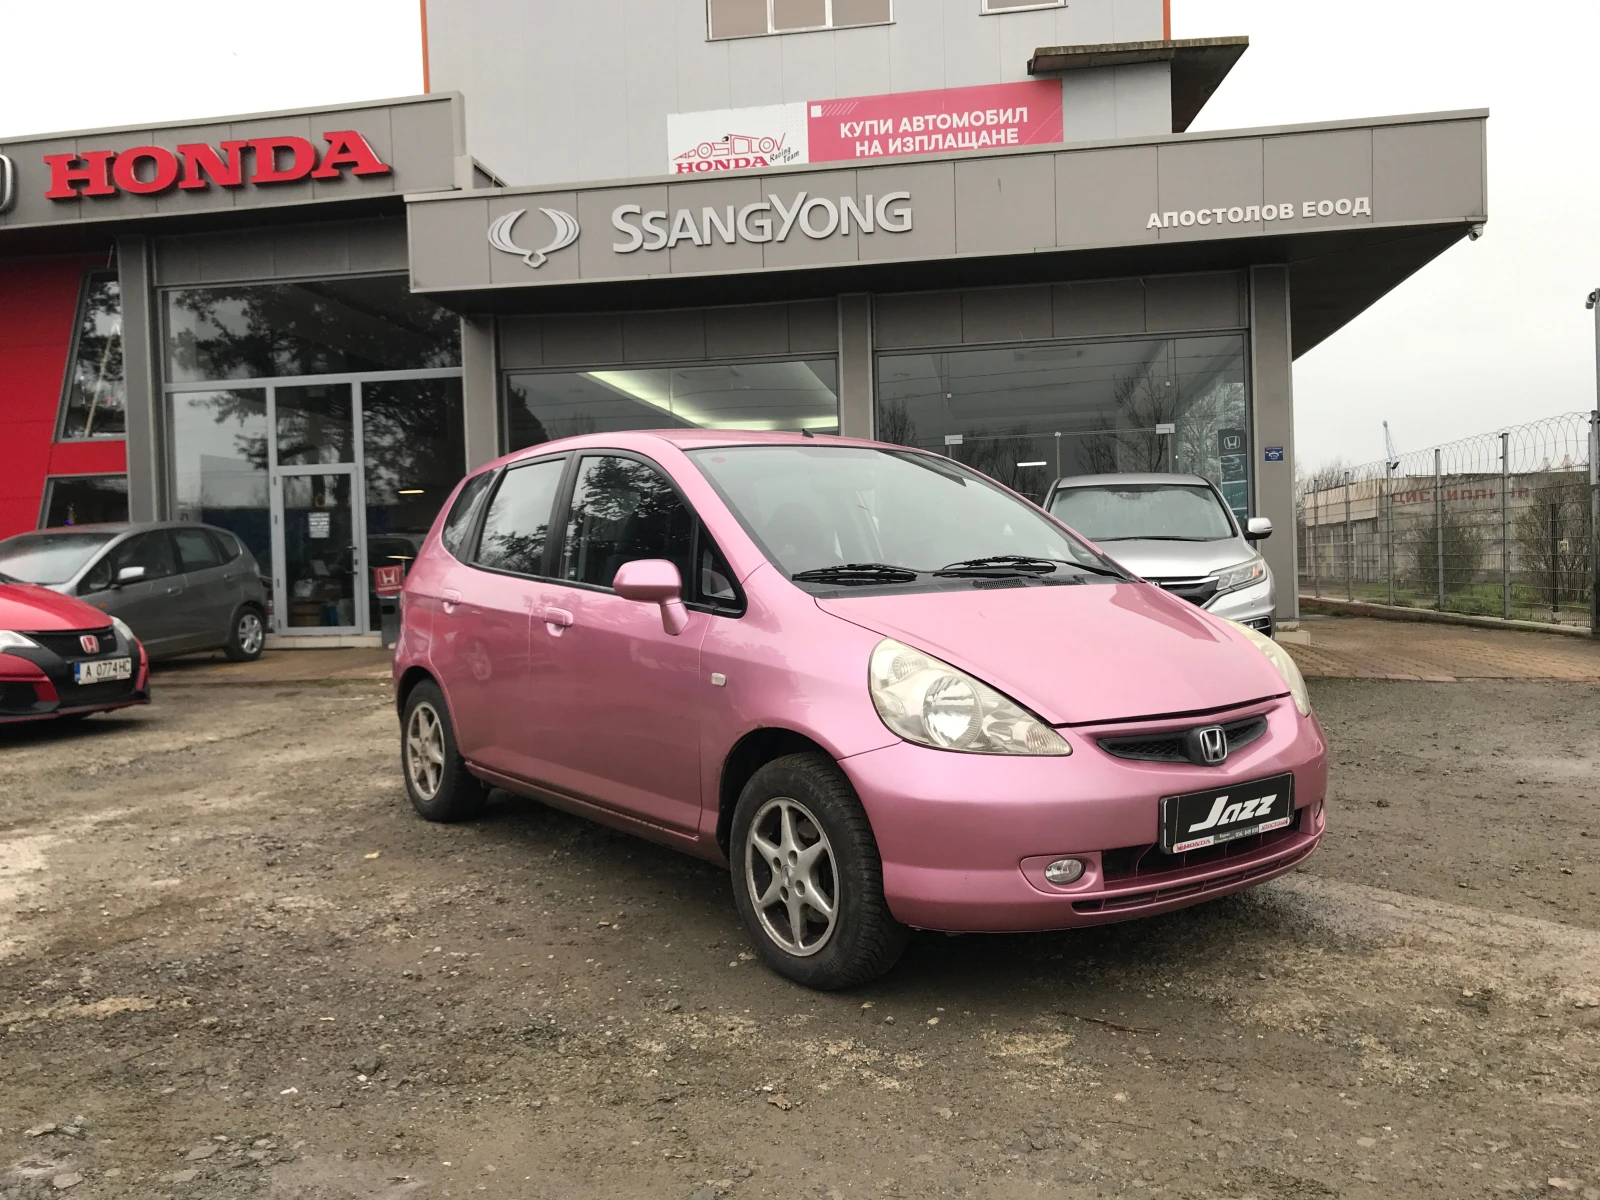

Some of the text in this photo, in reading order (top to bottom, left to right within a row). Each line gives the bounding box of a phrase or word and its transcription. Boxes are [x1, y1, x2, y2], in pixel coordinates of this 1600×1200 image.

[840, 107, 1028, 138] КУПИ АВТОМОБИЛ
[769, 147, 791, 162] Racing
[855, 128, 1019, 156] НА ИЗПЛАЩАНЕ
[43, 130, 392, 199] HONDA
[676, 156, 770, 174] HONDA
[783, 151, 800, 163] Team
[1146, 197, 1371, 229] АПОСТОЛОВ ЕООД
[86, 665, 92, 677] A
[97, 662, 118, 676] 0774
[1188, 794, 1277, 832] Jazz
